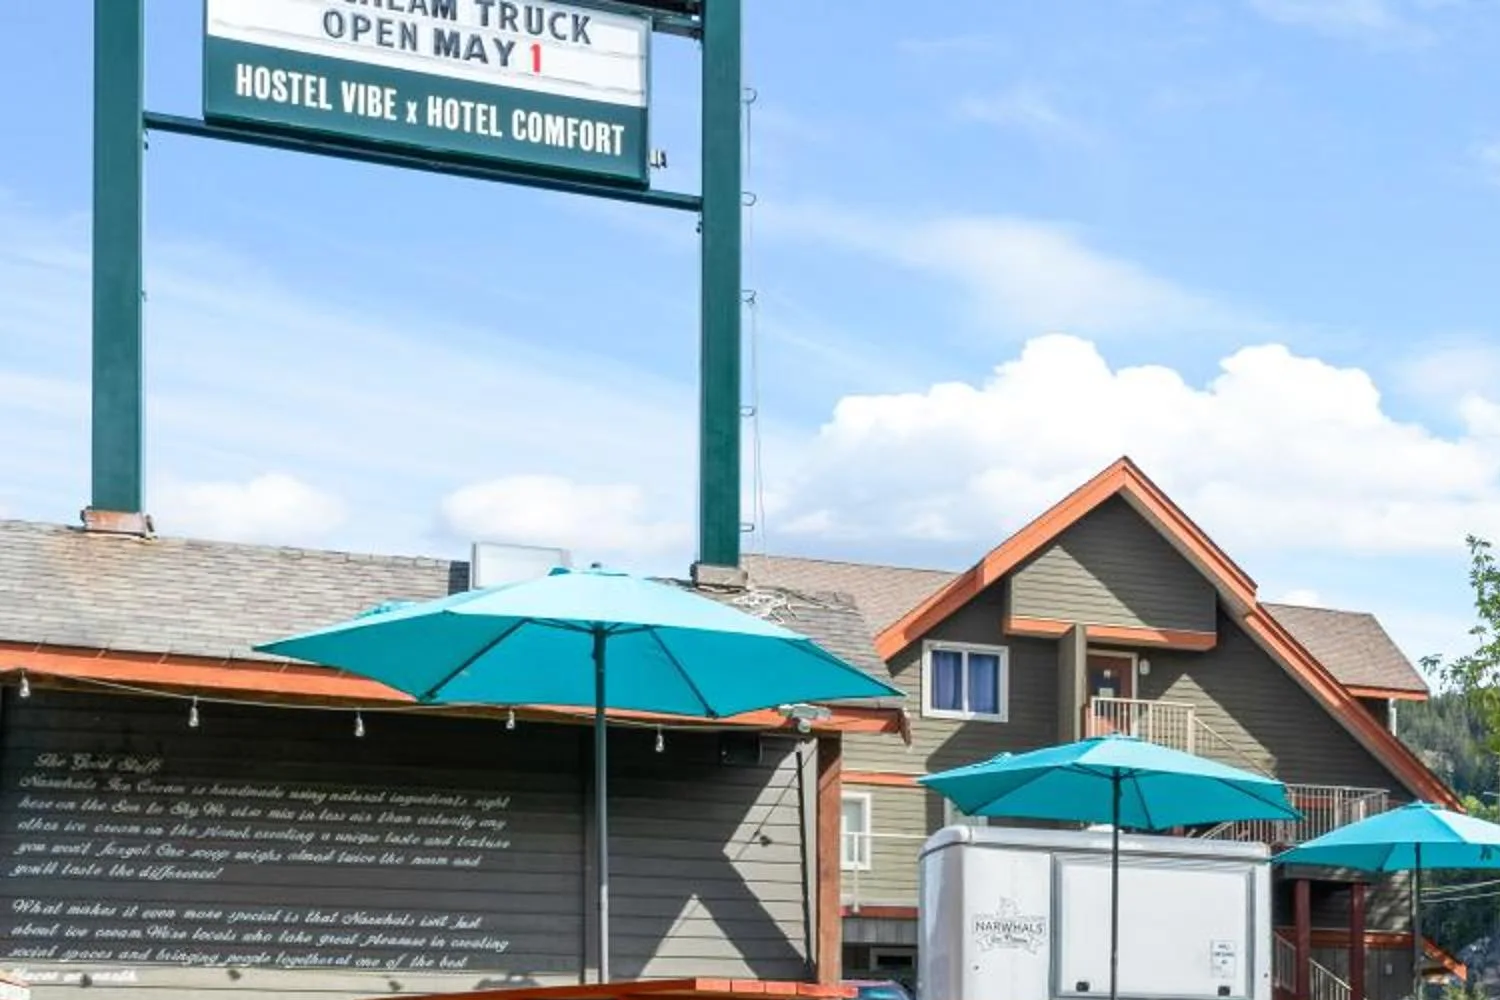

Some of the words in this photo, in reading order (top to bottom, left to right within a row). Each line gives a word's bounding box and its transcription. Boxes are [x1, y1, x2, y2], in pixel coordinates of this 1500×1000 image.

[476, 0, 592, 44] TRUCK
[323, 9, 417, 51] OPEN
[433, 28, 516, 67] MAY
[530, 43, 541, 73] 1
[236, 63, 333, 111] HOSTEL
[341, 80, 398, 121] VIBE
[427, 95, 502, 137] HOTEL
[512, 109, 624, 156] COMFORT
[81, 798, 107, 811] the
[169, 823, 197, 836] the
[108, 864, 135, 876] the
[12, 899, 64, 914] What
[66, 903, 117, 916] makes
[122, 905, 139, 918] it
[141, 909, 177, 919] even
[183, 910, 223, 919] more
[227, 909, 283, 924] special
[284, 912, 299, 922] is
[304, 910, 340, 923] that
[10, 923, 61, 936] about
[65, 925, 89, 937] ice
[192, 927, 237, 941] locals
[242, 929, 273, 942] who
[278, 930, 313, 943] take
[315, 932, 359, 946] great
[430, 935, 446, 947] in
[450, 935, 510, 953] creating
[975, 921, 1044, 934] NARWHALS
[7, 945, 59, 957] social
[61, 949, 113, 962] spaces
[118, 948, 153, 960] and
[155, 949, 219, 966] bringing
[225, 952, 272, 966] people
[355, 957, 381, 967] one
[385, 953, 406, 970] of
[409, 954, 435, 968] the
[439, 956, 468, 968] best
